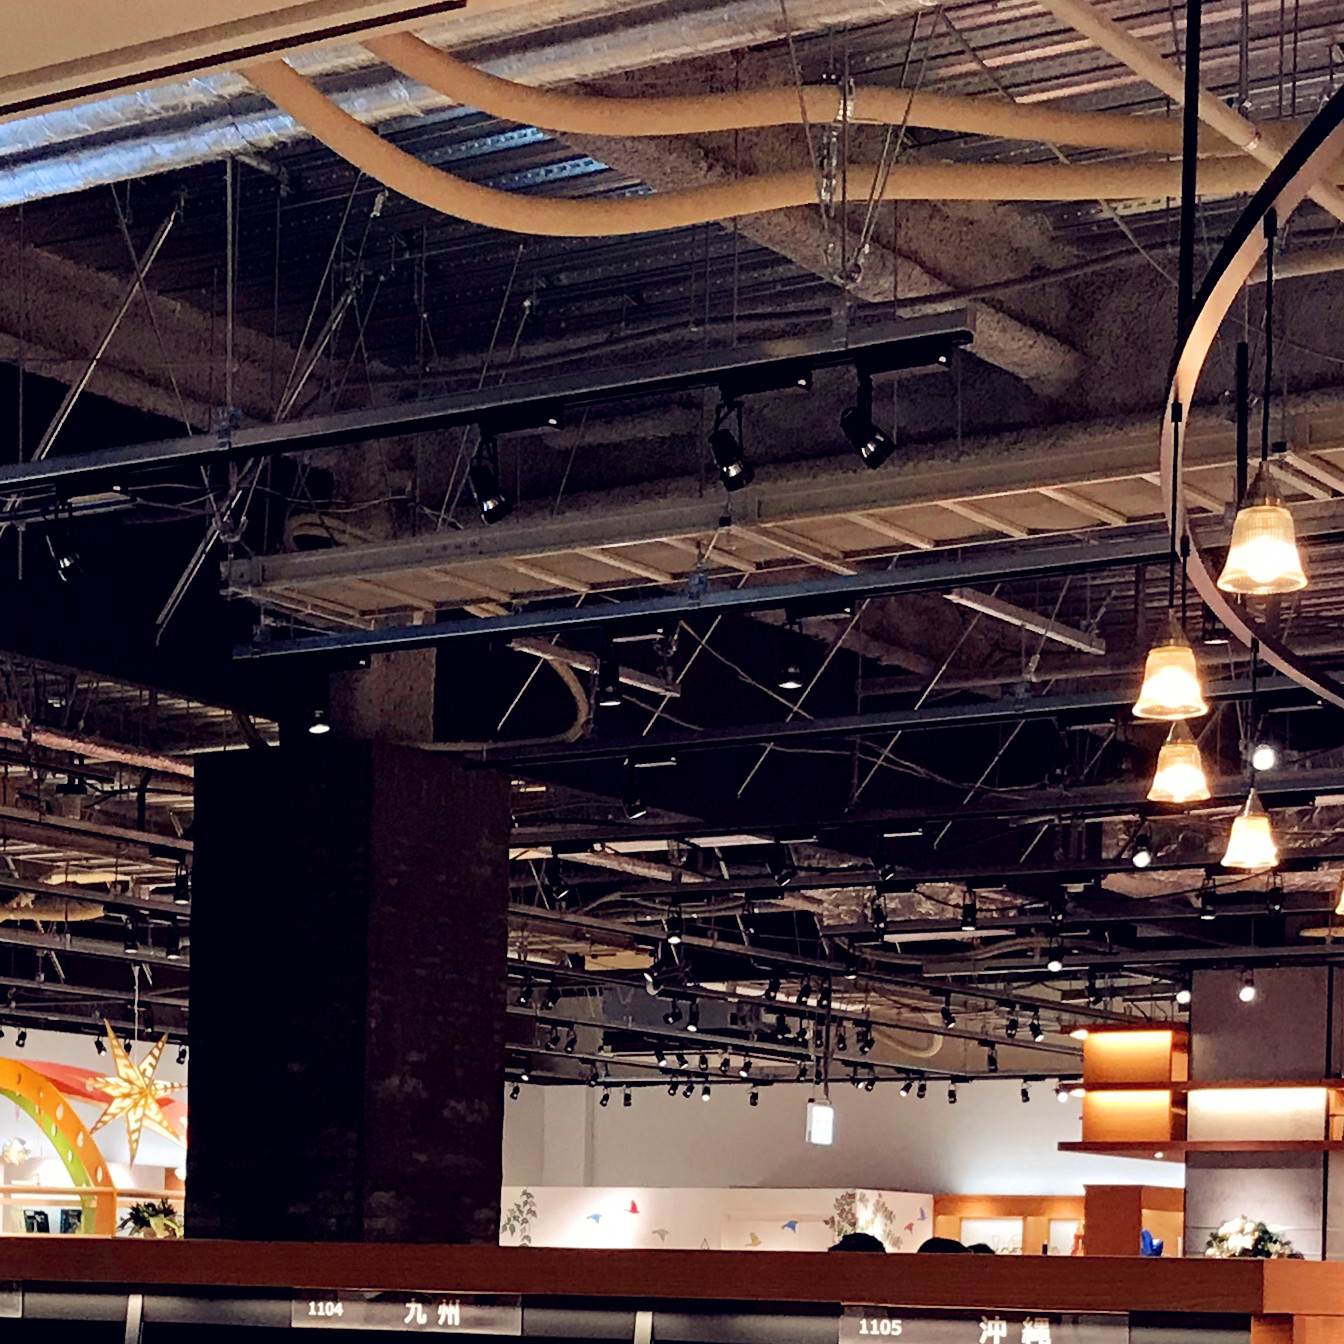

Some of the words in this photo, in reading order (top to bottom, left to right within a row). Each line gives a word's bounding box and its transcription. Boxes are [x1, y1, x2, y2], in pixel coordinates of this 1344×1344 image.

[308, 1301, 344, 1318] 1104
[404, 1302, 460, 1326] 九州
[859, 1318, 902, 1336] 1105
